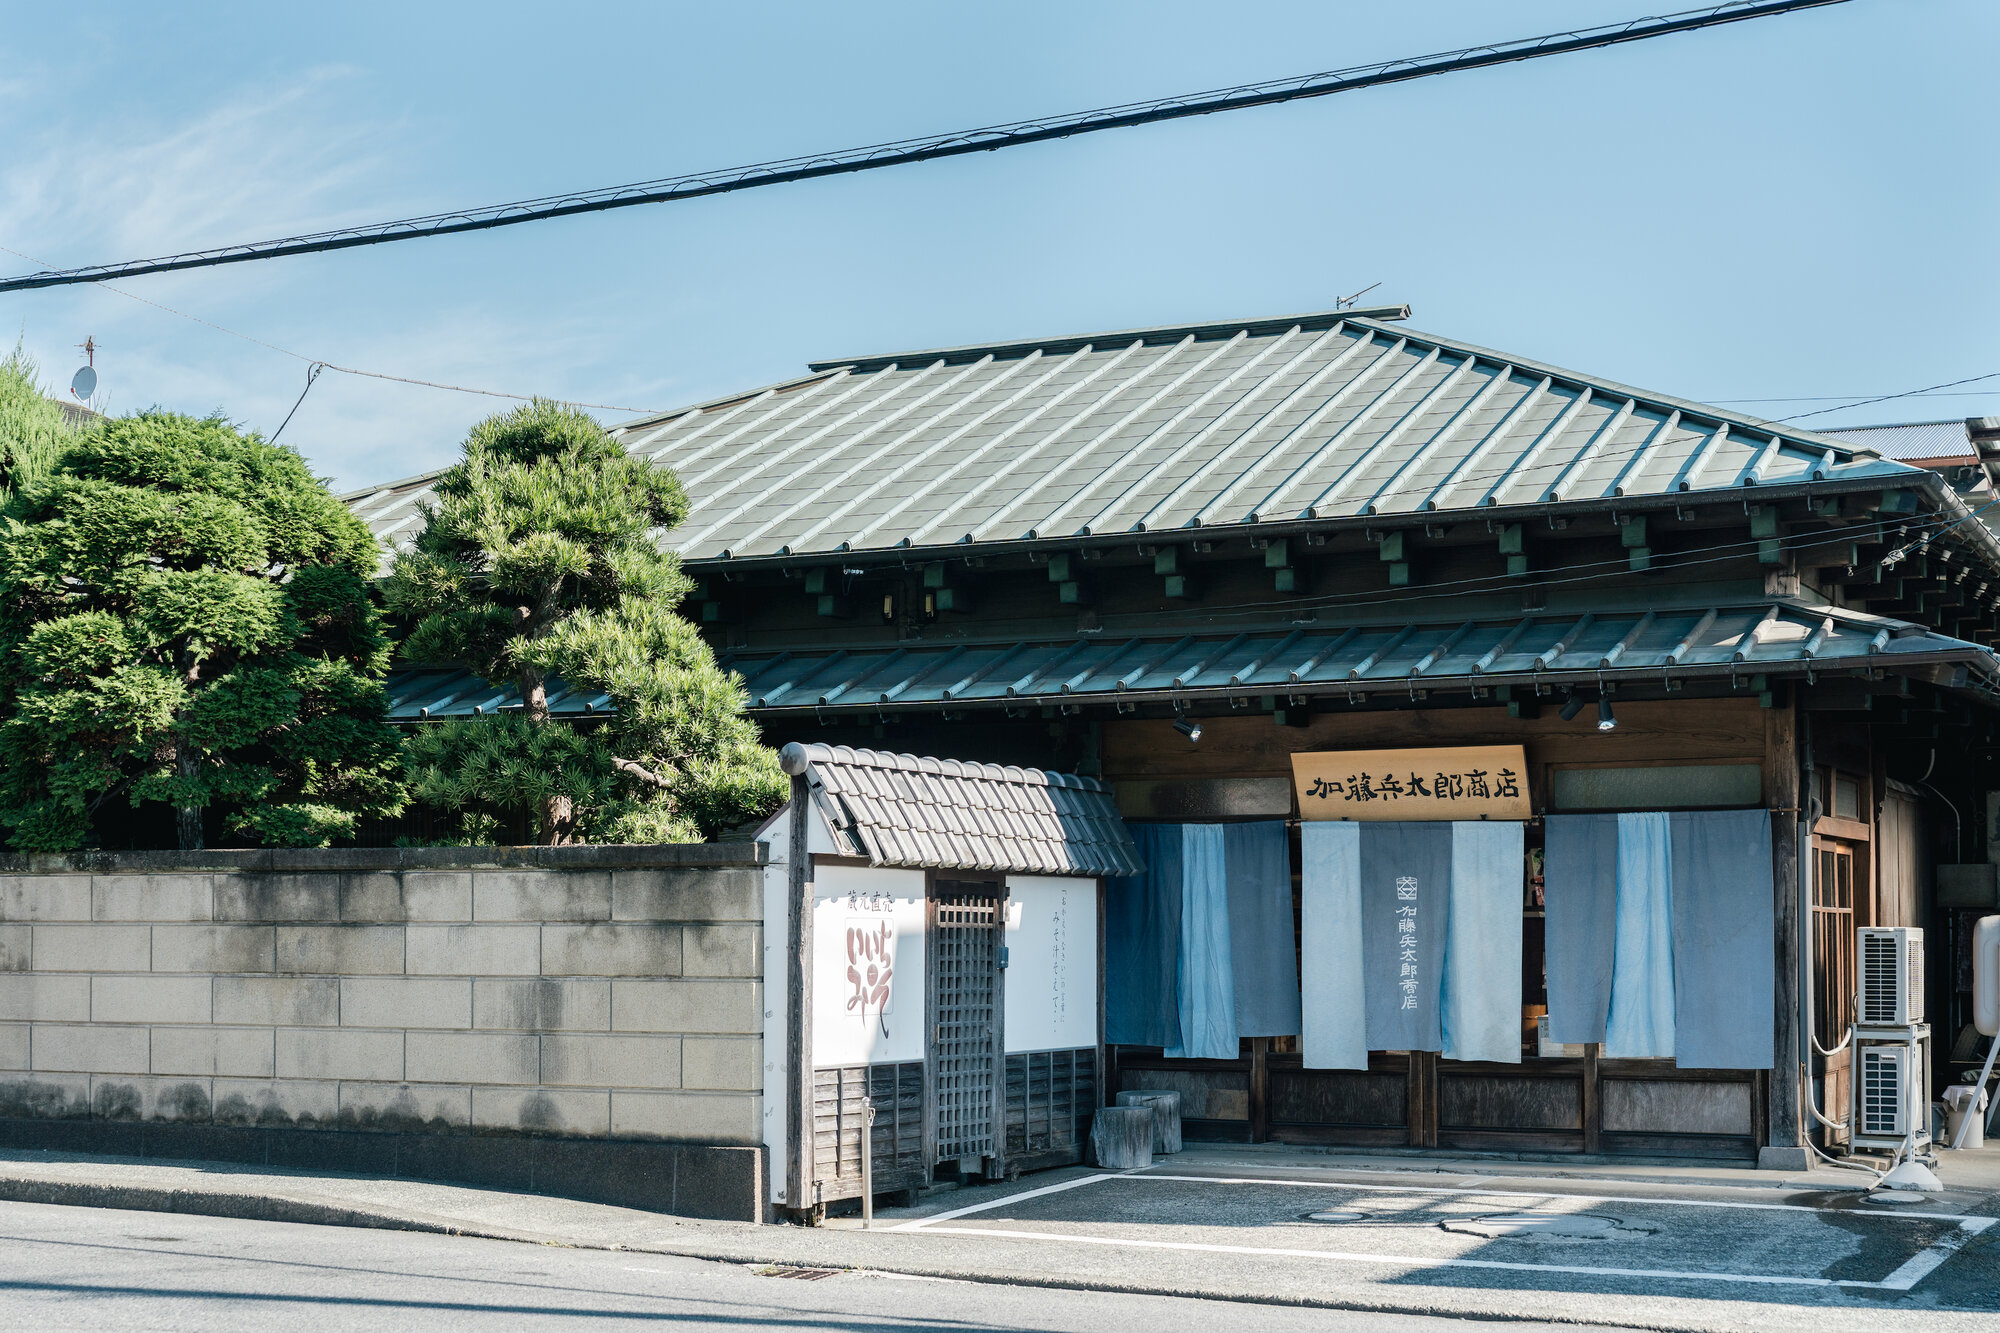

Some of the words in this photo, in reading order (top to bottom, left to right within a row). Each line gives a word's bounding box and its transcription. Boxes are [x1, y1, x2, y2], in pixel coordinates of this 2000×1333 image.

[1306, 767, 1520, 802] 加藤兵太郎商店
[848, 889, 893, 913] 蔵元直売
[1396, 905, 1419, 1010] 加藤兵太郎商店
